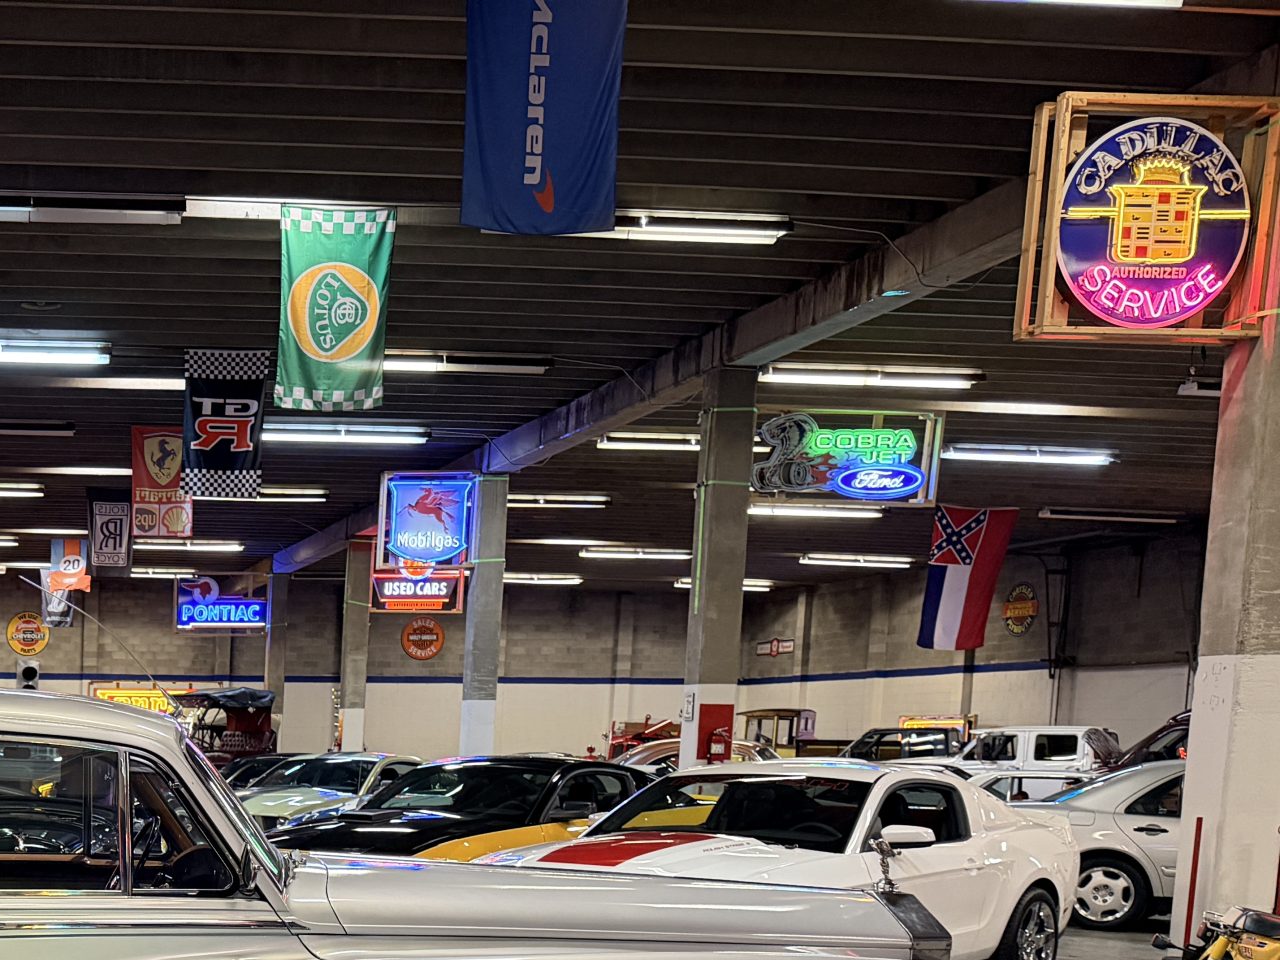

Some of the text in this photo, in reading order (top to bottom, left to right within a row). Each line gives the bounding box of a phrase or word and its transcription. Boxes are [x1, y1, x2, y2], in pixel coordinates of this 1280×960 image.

[1076, 124, 1244, 195] CADILLAC
[1112, 267, 1187, 279] AUTHORIZED
[1083, 264, 1223, 318] SERVICE
[314, 274, 340, 349] LOTUS
[816, 434, 914, 449] COBRA
[863, 450, 911, 464] JET
[852, 470, 904, 488] Ford
[397, 530, 460, 550] Mobilgas
[63, 559, 80, 571] 20
[384, 582, 447, 595] USED CARS
[182, 604, 260, 621] PONTIAC
[412, 619, 434, 628] SALES
[408, 646, 437, 656] SERVICE
